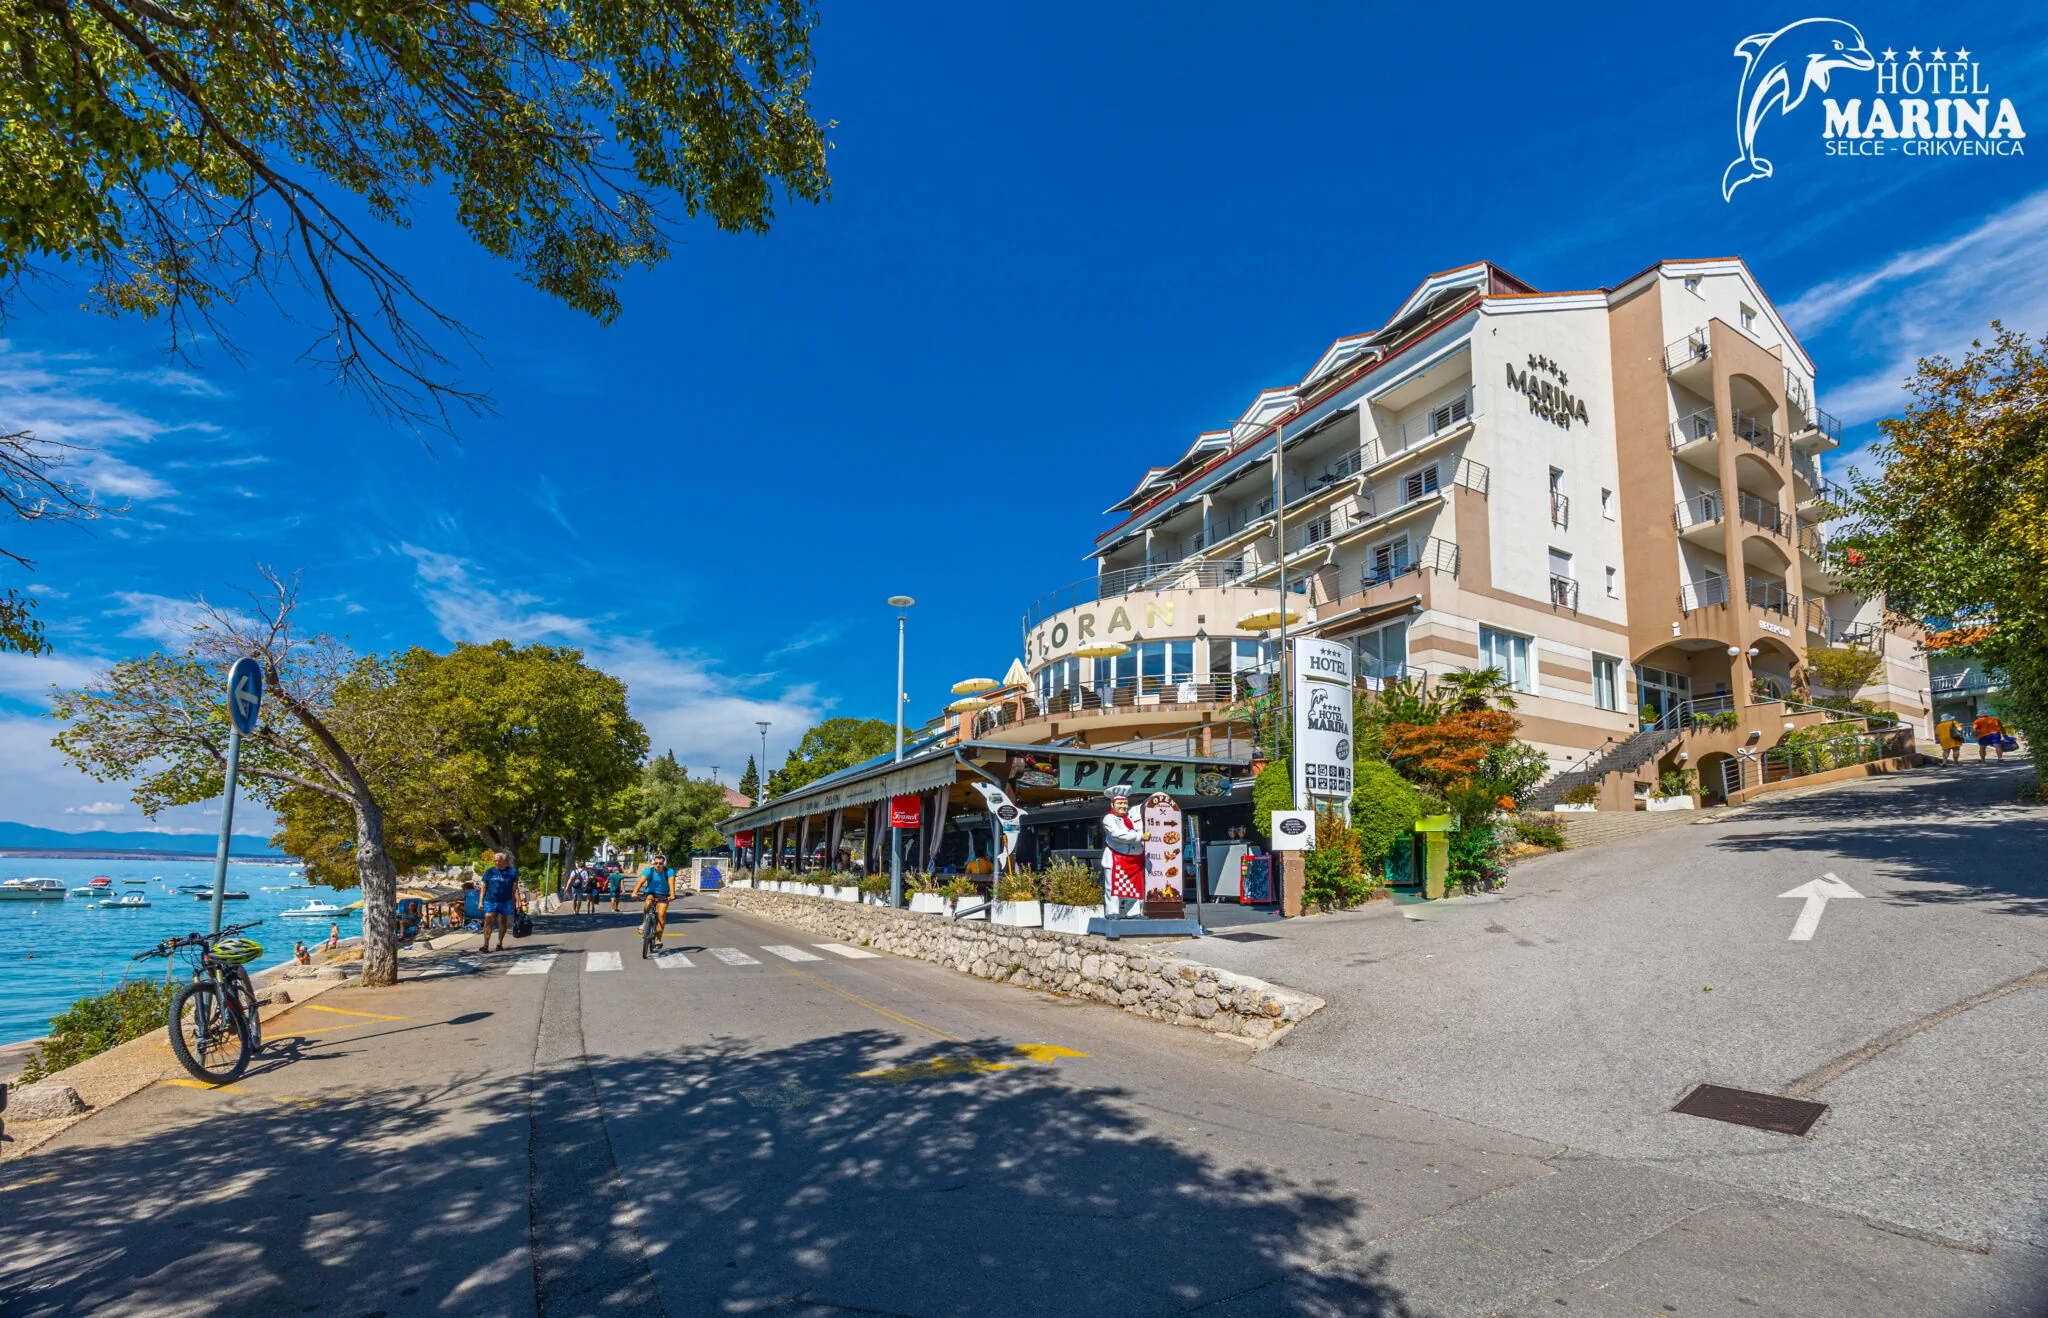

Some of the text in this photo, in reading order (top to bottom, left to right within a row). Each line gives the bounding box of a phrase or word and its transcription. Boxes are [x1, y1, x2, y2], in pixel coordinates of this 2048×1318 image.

[1506, 362, 1590, 427] MARINA
[1310, 656, 1347, 676] HOTEL
[1319, 710, 1343, 722] HOTEL
[1308, 718, 1349, 735] MARINA
[1074, 760, 1184, 790] PIZZA
[1152, 796, 1177, 807] OPEN
